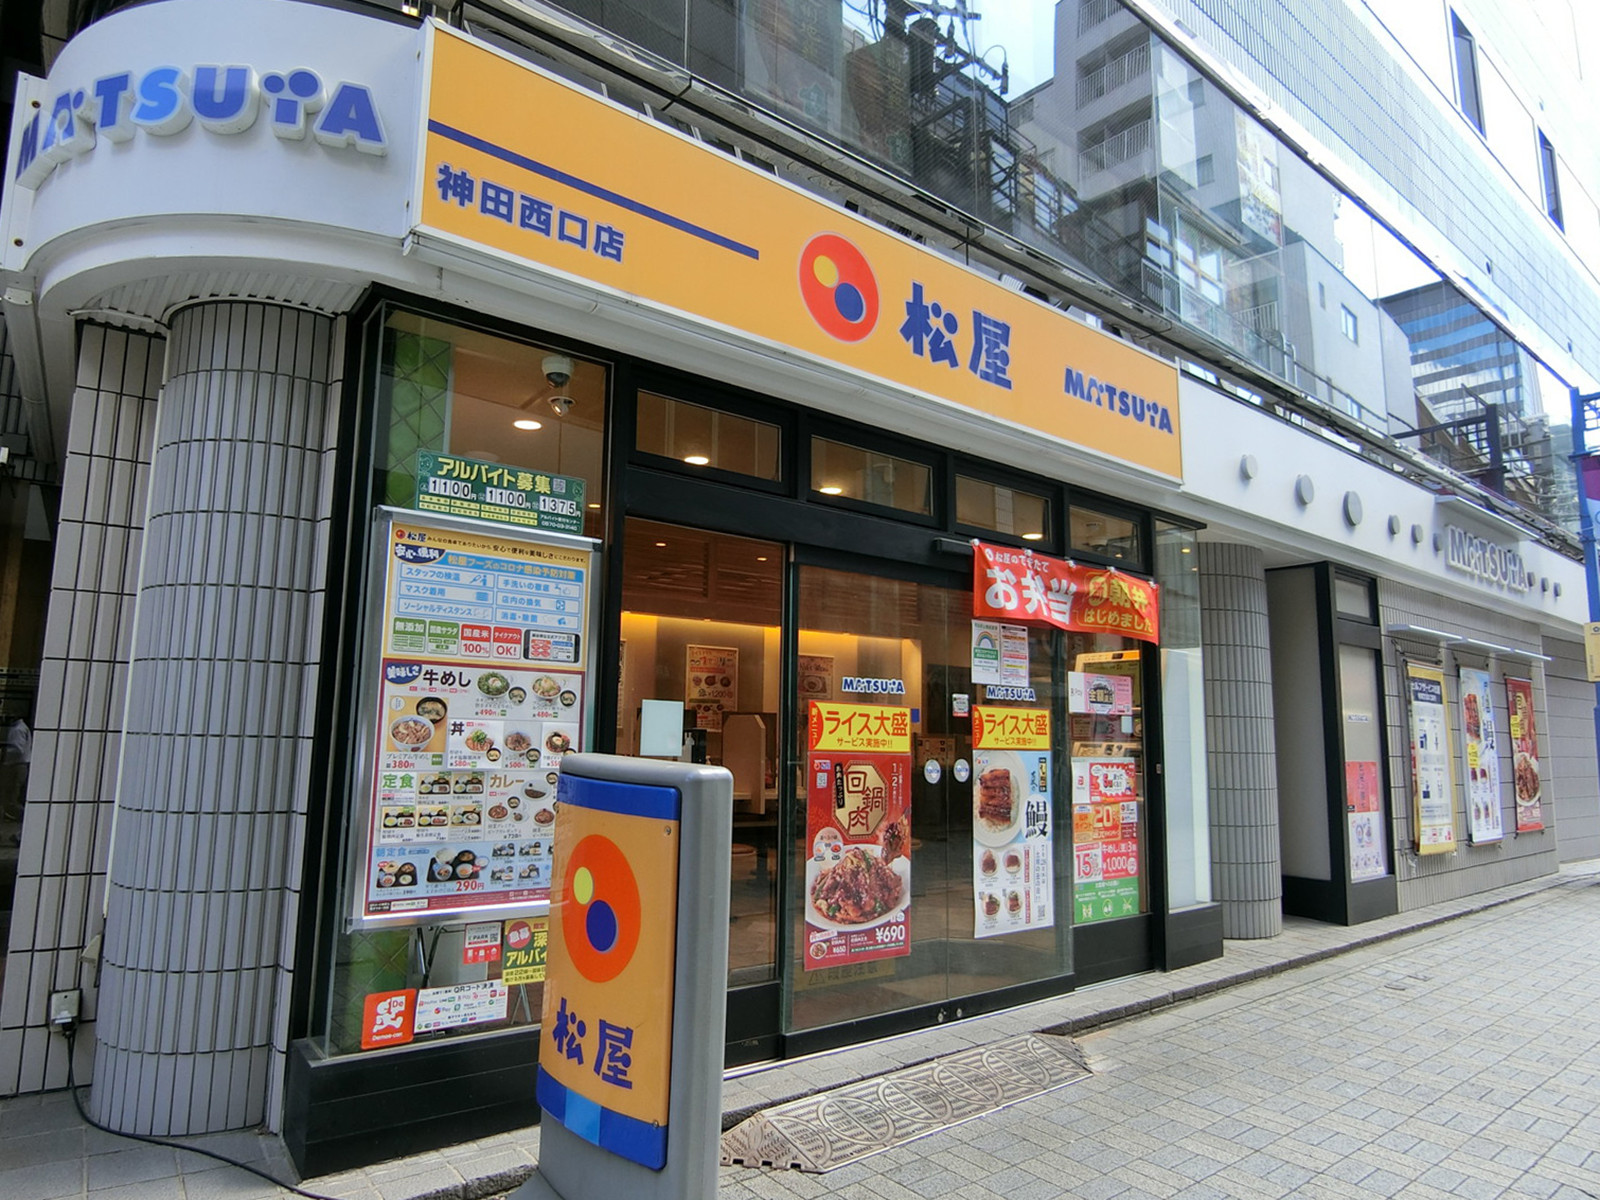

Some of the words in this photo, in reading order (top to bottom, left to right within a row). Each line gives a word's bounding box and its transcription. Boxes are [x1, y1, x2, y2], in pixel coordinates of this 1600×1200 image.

[15, 63, 388, 182] MATSUYA
[436, 162, 624, 264] 神田西口店
[898, 278, 1013, 391] 松屋
[1064, 366, 1174, 436] MATSUYA
[437, 457, 551, 494] アルバイト募集
[407, 531, 427, 542] 松屋
[1448, 523, 1529, 593] MATSUYA
[985, 565, 1077, 625] お弁当
[1084, 608, 1153, 632] はじめました
[494, 631, 520, 640] テイクアウト
[496, 645, 517, 656] OK!
[422, 669, 472, 688] 牛めし
[842, 677, 905, 694] MATSUYA
[987, 688, 1035, 700] MATSUYA
[451, 721, 465, 736] 丼
[825, 710, 908, 737] ライス大盛
[985, 713, 1047, 735] ライス大盛
[382, 774, 414, 789] 定食
[490, 774, 525, 788] カレー
[456, 880, 484, 891] 290円
[875, 925, 905, 943] ¥690
[392, 999, 403, 1008] De
[552, 997, 633, 1090] 松屋
